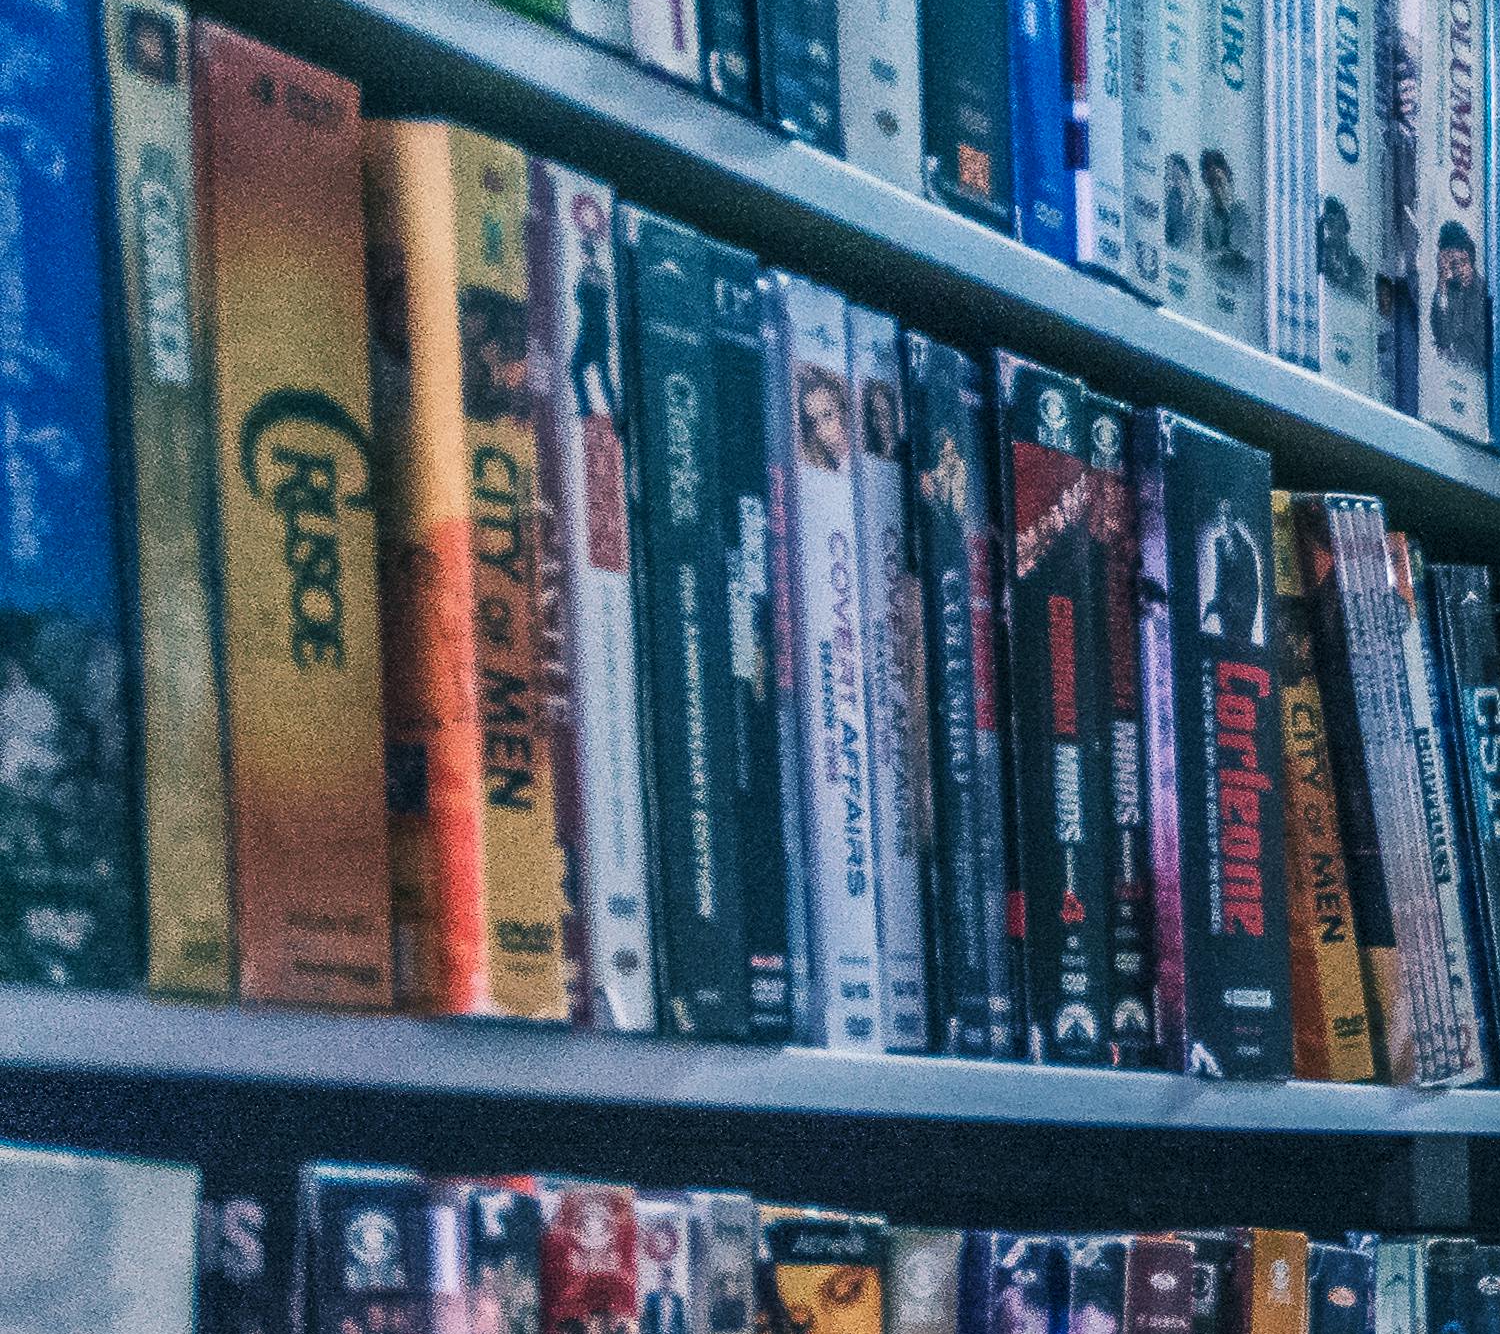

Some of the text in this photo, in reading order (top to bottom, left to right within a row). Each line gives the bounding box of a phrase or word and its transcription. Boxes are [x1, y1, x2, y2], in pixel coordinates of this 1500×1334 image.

[239, 390, 377, 668] CRUSOE
[471, 445, 516, 576] CITY
[482, 666, 536, 813] MEN
[829, 533, 867, 897] COVERT AFFAIRS
[1215, 660, 1270, 935] Corleone
[1285, 698, 1321, 798] CITY
[1312, 849, 1346, 946] MEN
